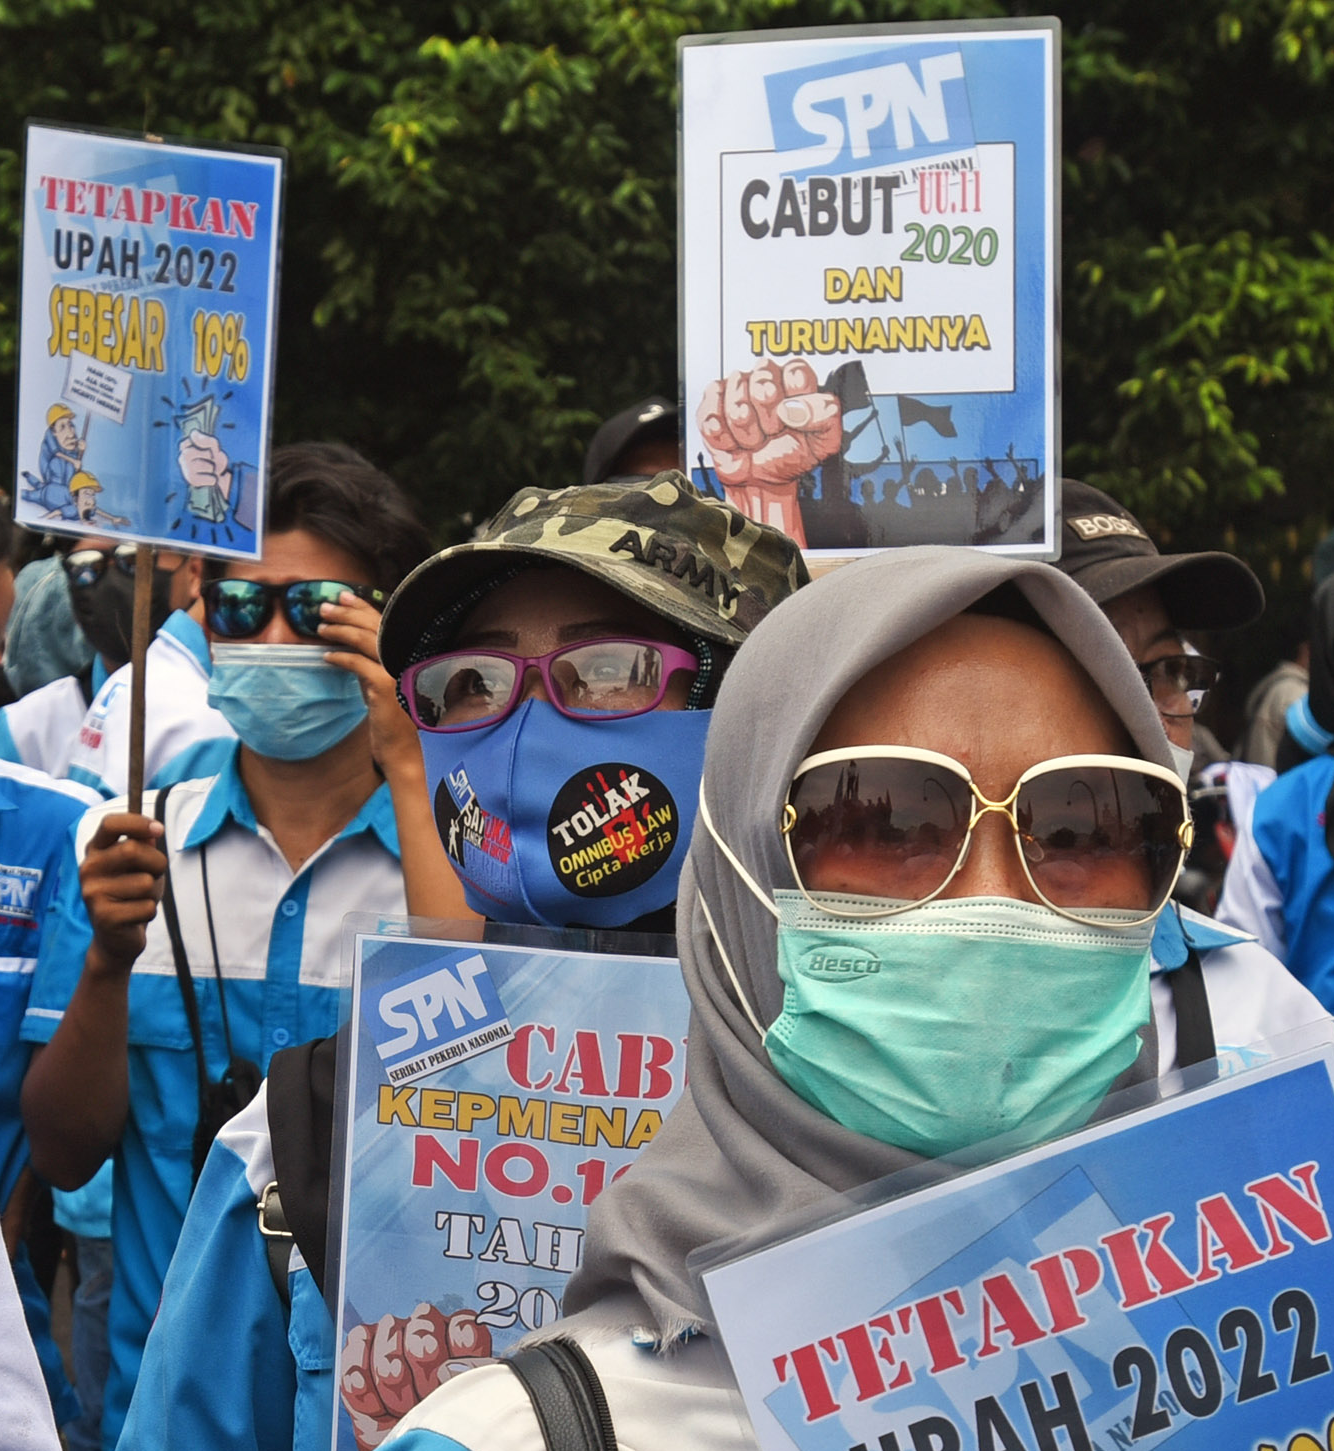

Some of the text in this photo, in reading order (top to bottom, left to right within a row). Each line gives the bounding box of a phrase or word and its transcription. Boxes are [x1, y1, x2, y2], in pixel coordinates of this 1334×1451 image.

[775, 51, 965, 174] SPN
[40, 176, 259, 239] TETAPKAN
[740, 175, 902, 240] CABUT
[54, 228, 237, 293] UPAH 2022
[900, 222, 1000, 266] 2020
[824, 266, 903, 303] DAN
[47, 283, 248, 381] SEBESAR 10%
[746, 314, 992, 356] TURUNANNYA
[609, 529, 742, 608] ARMY
[551, 772, 651, 848] TOLAK
[559, 826, 636, 875] OMNIBUS
[639, 804, 673, 837] LAW
[575, 830, 673, 888] Cipta Kerja
[377, 954, 488, 1060] SPN
[389, 1024, 512, 1083] SERIKAT PEKERJA NASIONAL
[506, 1024, 688, 1100] CAB
[378, 1084, 663, 1149] KEPMENA
[411, 1134, 635, 1206] NO.1
[435, 1211, 585, 1274] TAH
[477, 1281, 565, 1331] 20
[773, 1161, 1332, 1424] TETAPKAN
[1112, 1287, 1332, 1442] 2022
